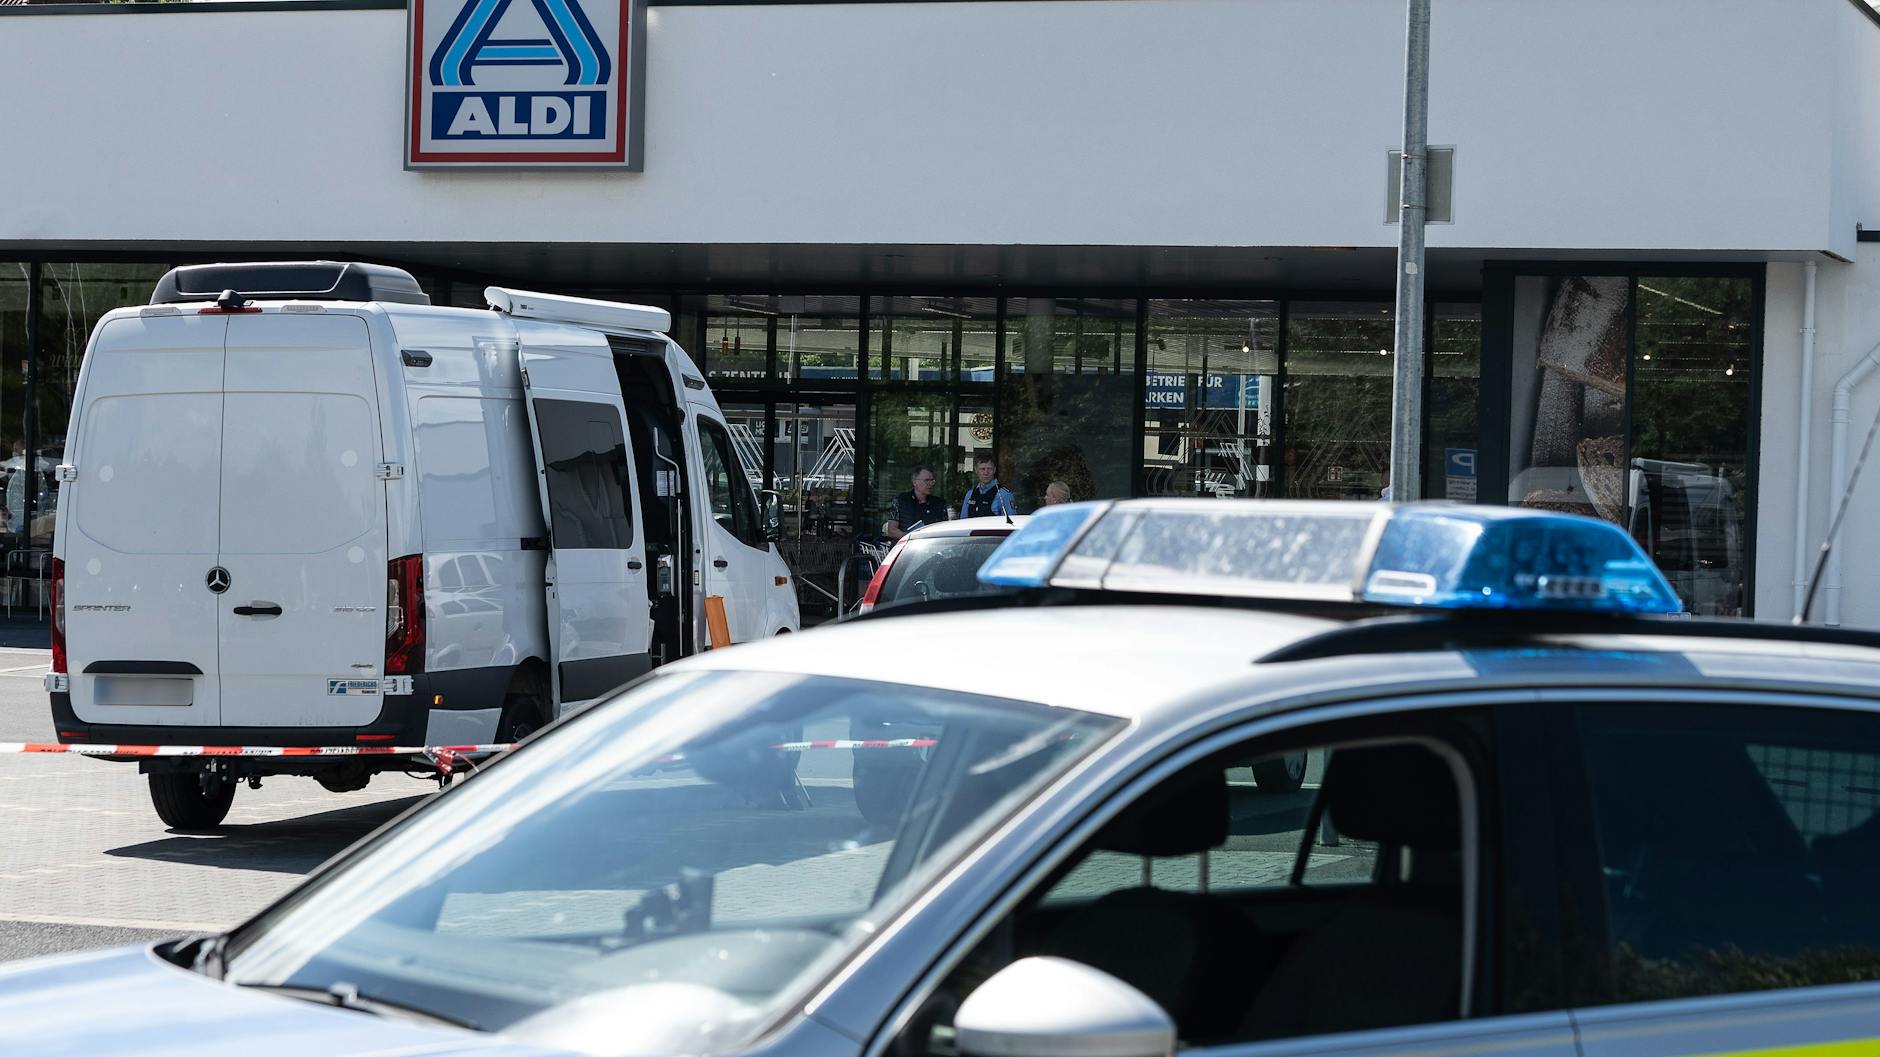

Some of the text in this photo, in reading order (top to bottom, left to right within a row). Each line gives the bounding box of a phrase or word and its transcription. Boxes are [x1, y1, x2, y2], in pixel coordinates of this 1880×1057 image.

[446, 95, 591, 135] ALDI
[1197, 374, 1223, 389] FÜR
[72, 604, 132, 612] SPRINTER
